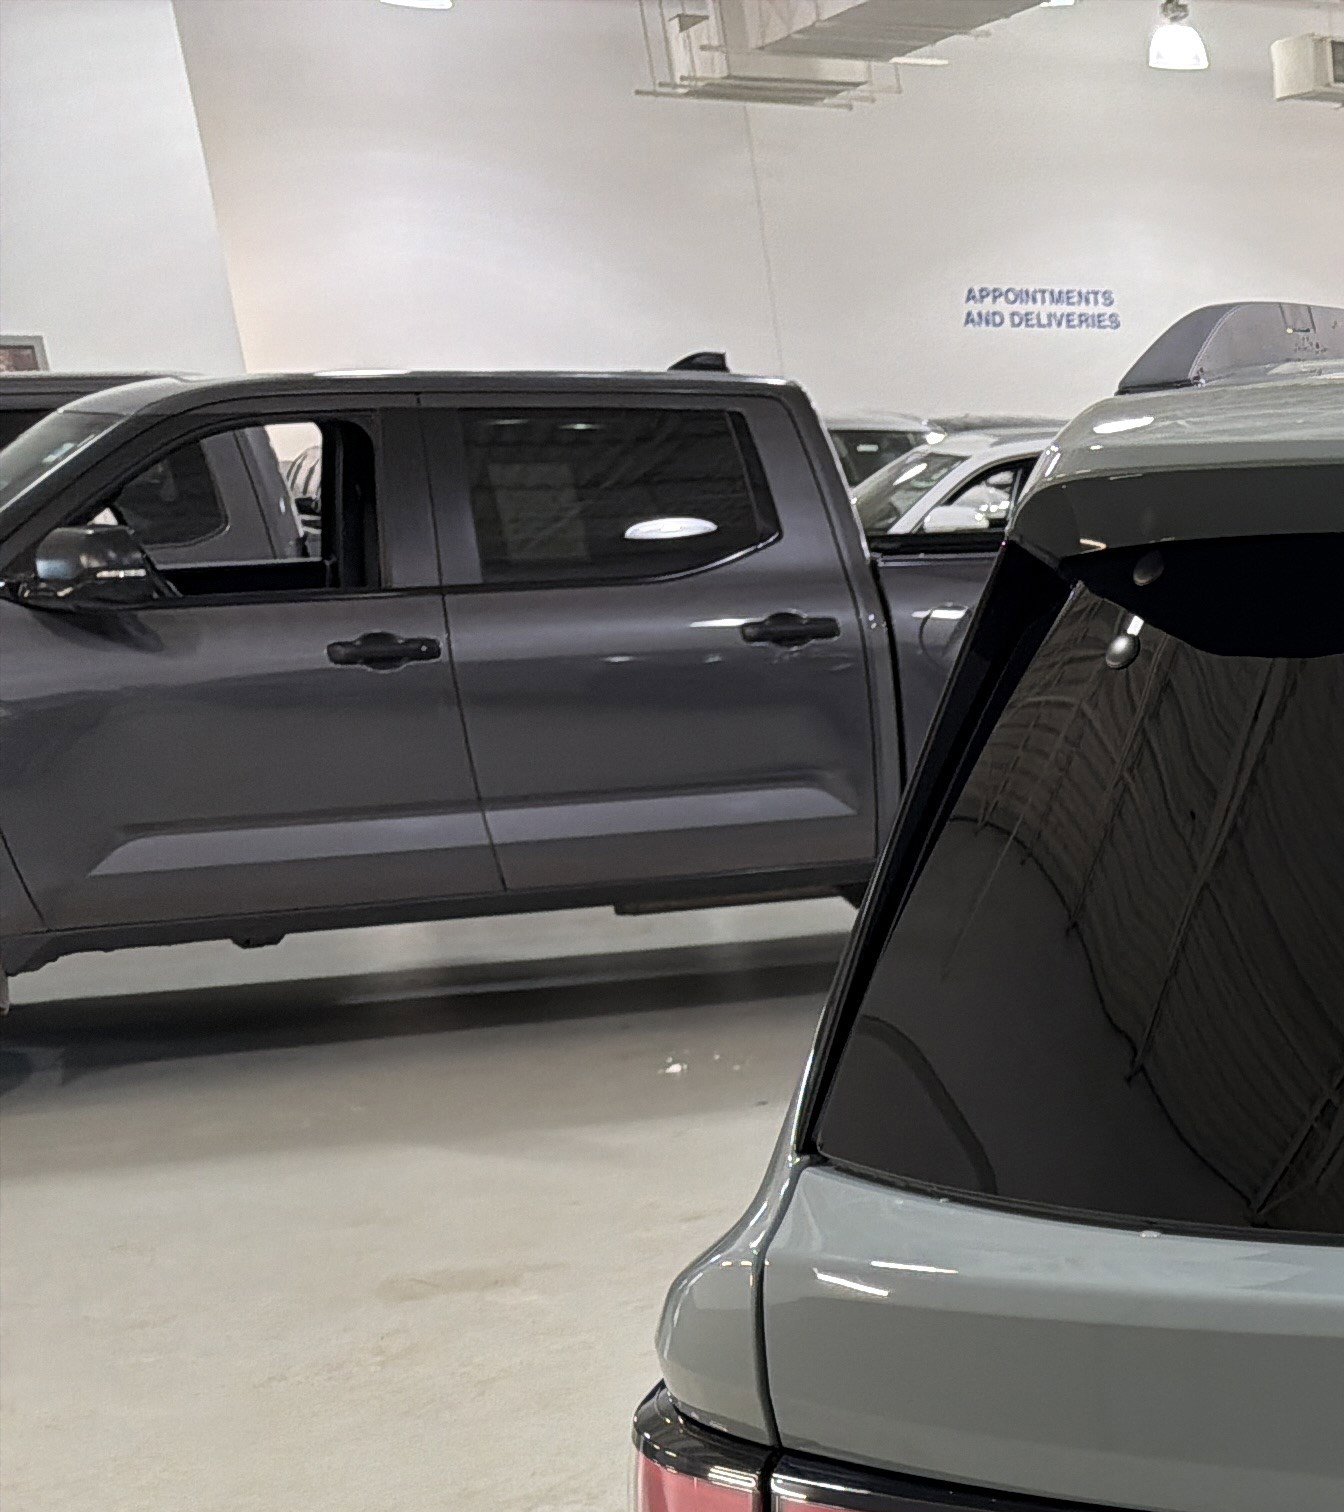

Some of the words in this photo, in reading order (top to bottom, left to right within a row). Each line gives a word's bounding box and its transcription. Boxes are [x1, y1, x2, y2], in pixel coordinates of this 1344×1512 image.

[965, 287, 1115, 307] APPOINTMENTS
[964, 310, 1005, 328] AND
[1009, 311, 1121, 330] DELIVERIES
